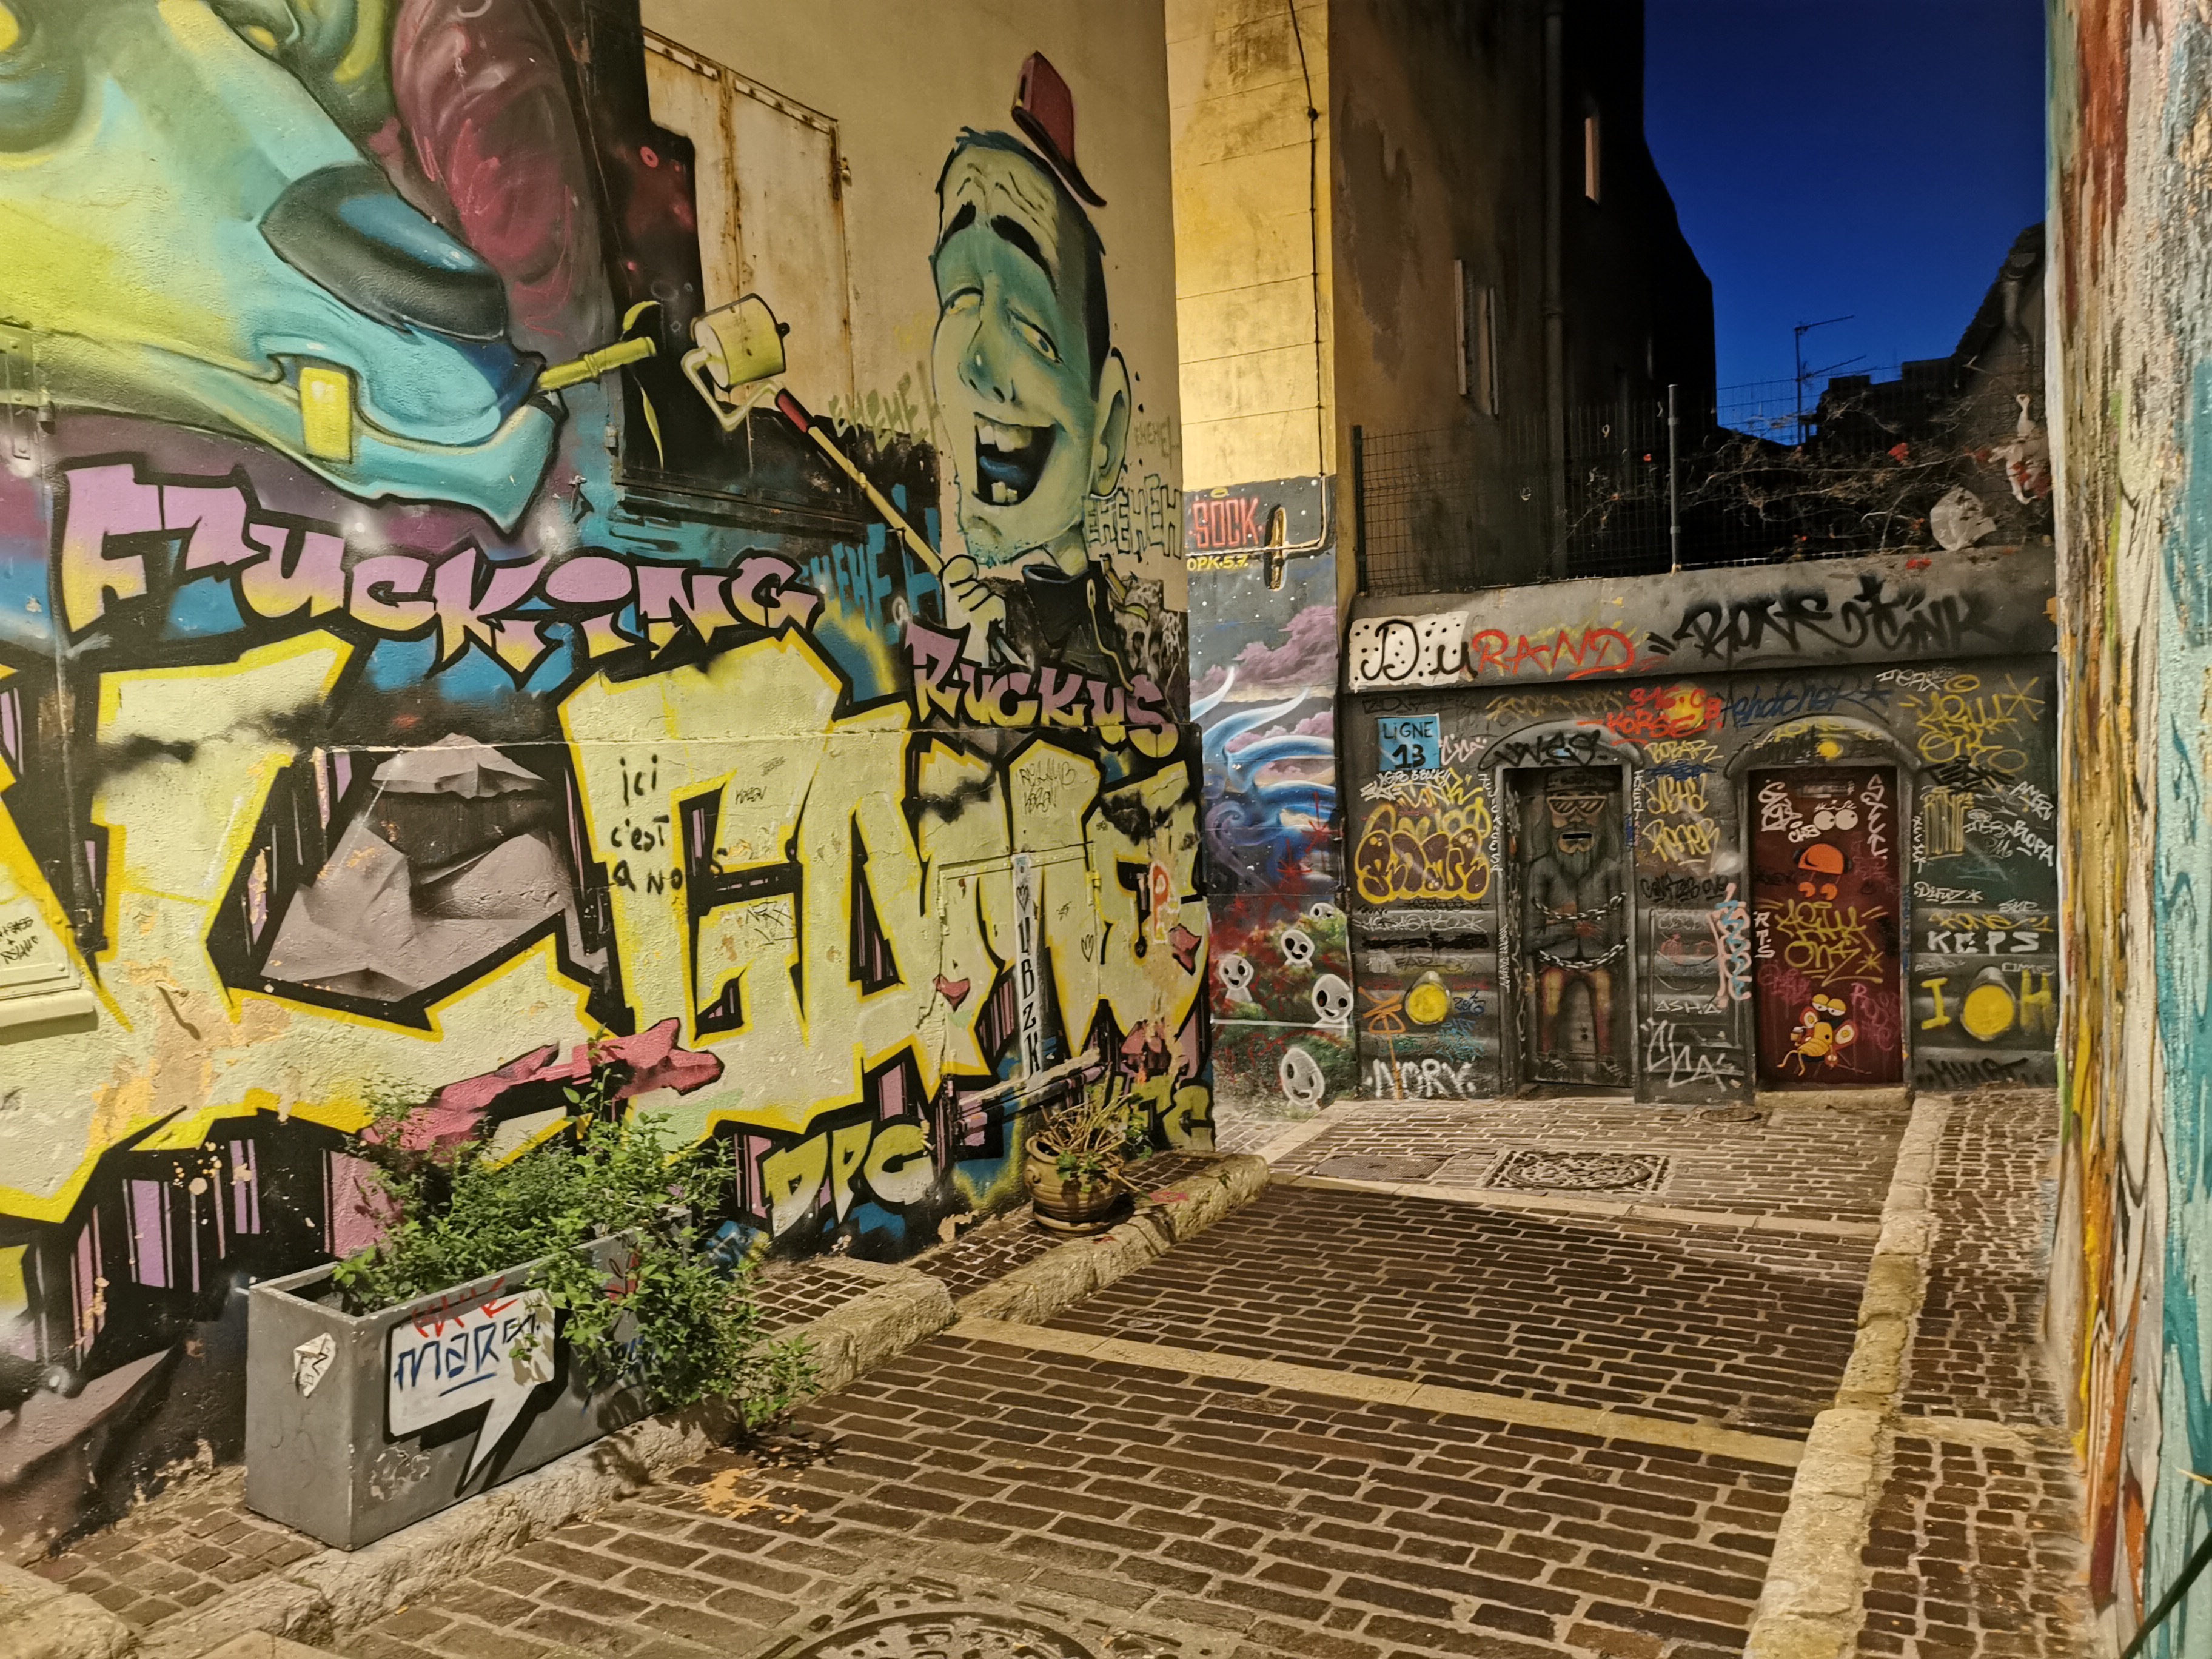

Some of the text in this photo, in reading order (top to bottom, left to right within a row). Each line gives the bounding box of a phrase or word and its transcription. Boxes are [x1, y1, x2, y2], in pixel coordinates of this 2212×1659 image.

[61, 462, 821, 675] FUCKING
[905, 621, 1180, 758] RUCKUS
[619, 754, 658, 806] ici
[1392, 743, 1426, 768] 13
